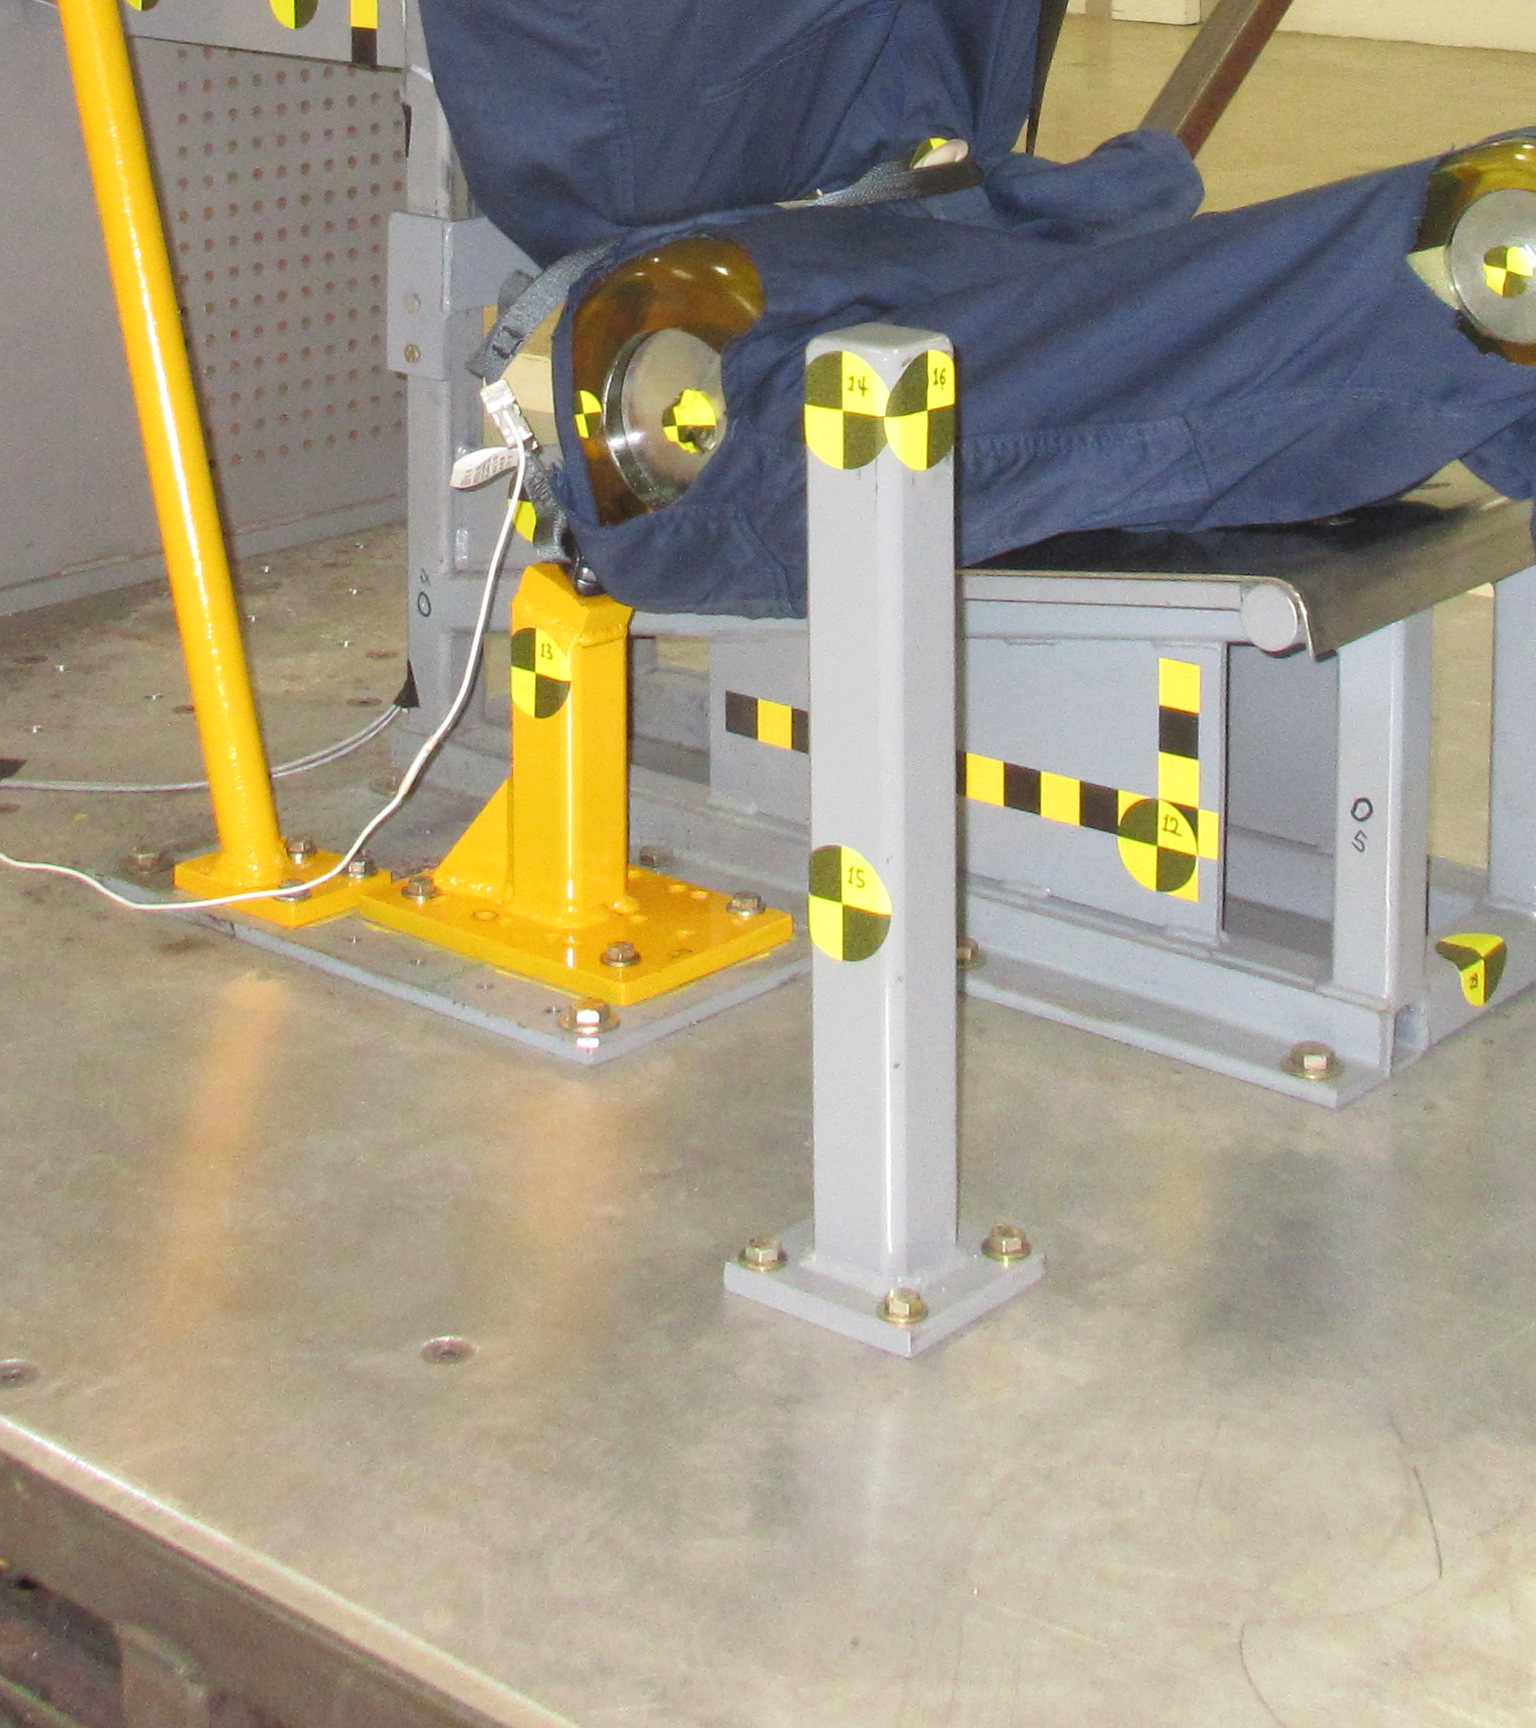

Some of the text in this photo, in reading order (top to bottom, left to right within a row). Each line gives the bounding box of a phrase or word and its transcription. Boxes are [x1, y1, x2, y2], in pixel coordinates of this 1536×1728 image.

[847, 374, 868, 398] 14
[932, 367, 946, 388] 16
[540, 642, 554, 661] 13
[1161, 813, 1183, 838] 12
[848, 865, 866, 889] 15
